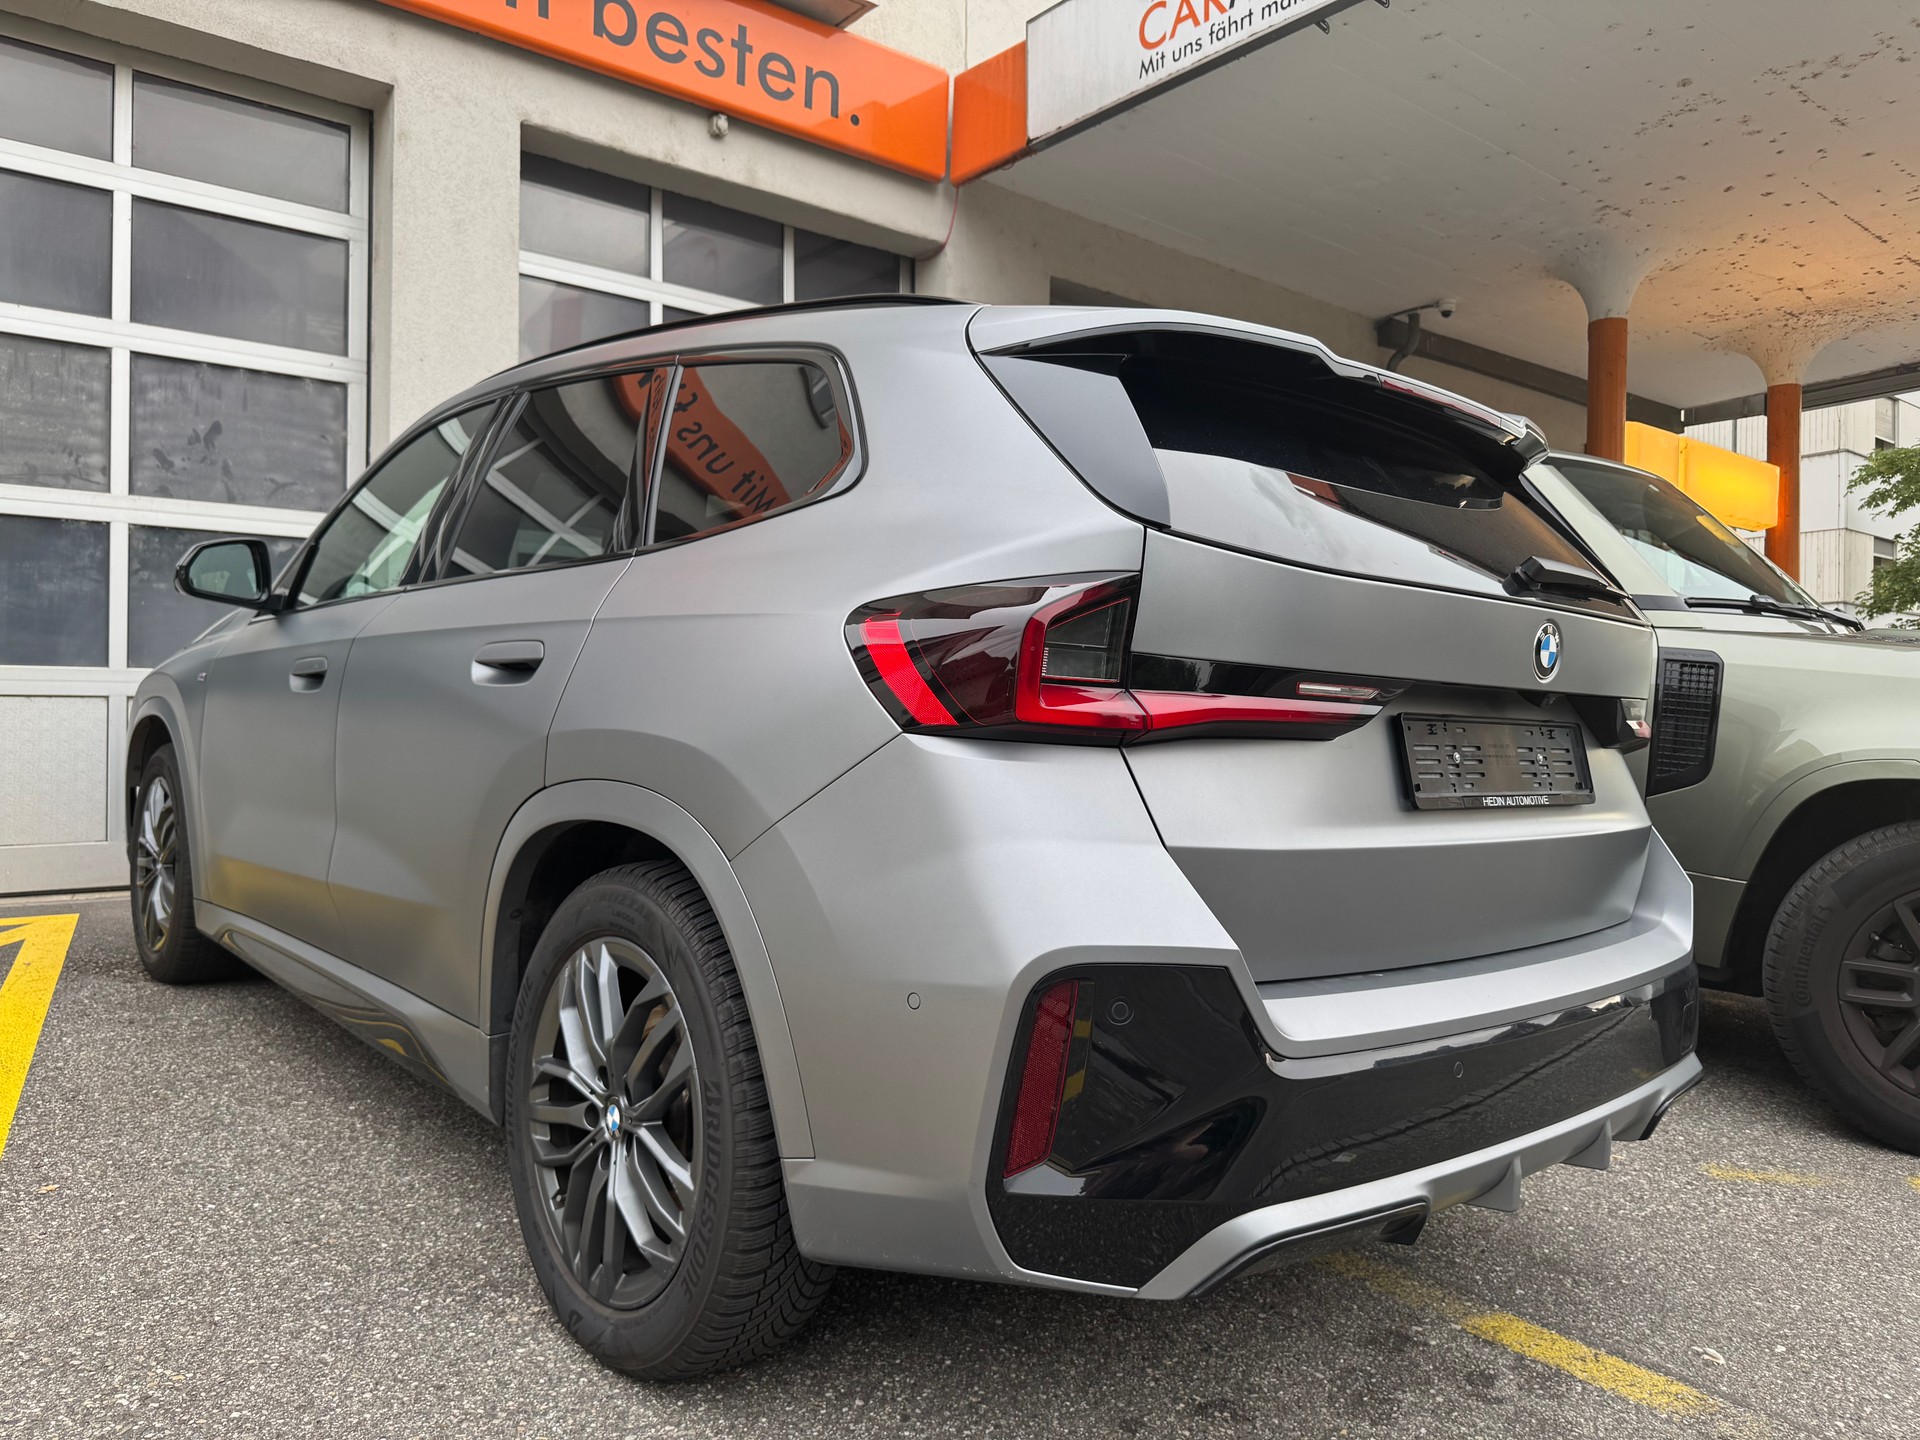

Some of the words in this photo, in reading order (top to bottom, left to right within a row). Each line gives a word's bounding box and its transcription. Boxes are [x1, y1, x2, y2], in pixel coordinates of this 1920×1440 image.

[1138, 0, 1236, 51] CA
[1139, 50, 1166, 80] Mit
[1172, 37, 1202, 62] uns
[1208, 8, 1254, 45] fährt
[593, 0, 861, 126] besten.
[1482, 796, 1505, 807] HEDIN
[1506, 795, 1550, 806] AUTOMOTIVE
[681, 1080, 722, 1302] BRIDGESTONE
